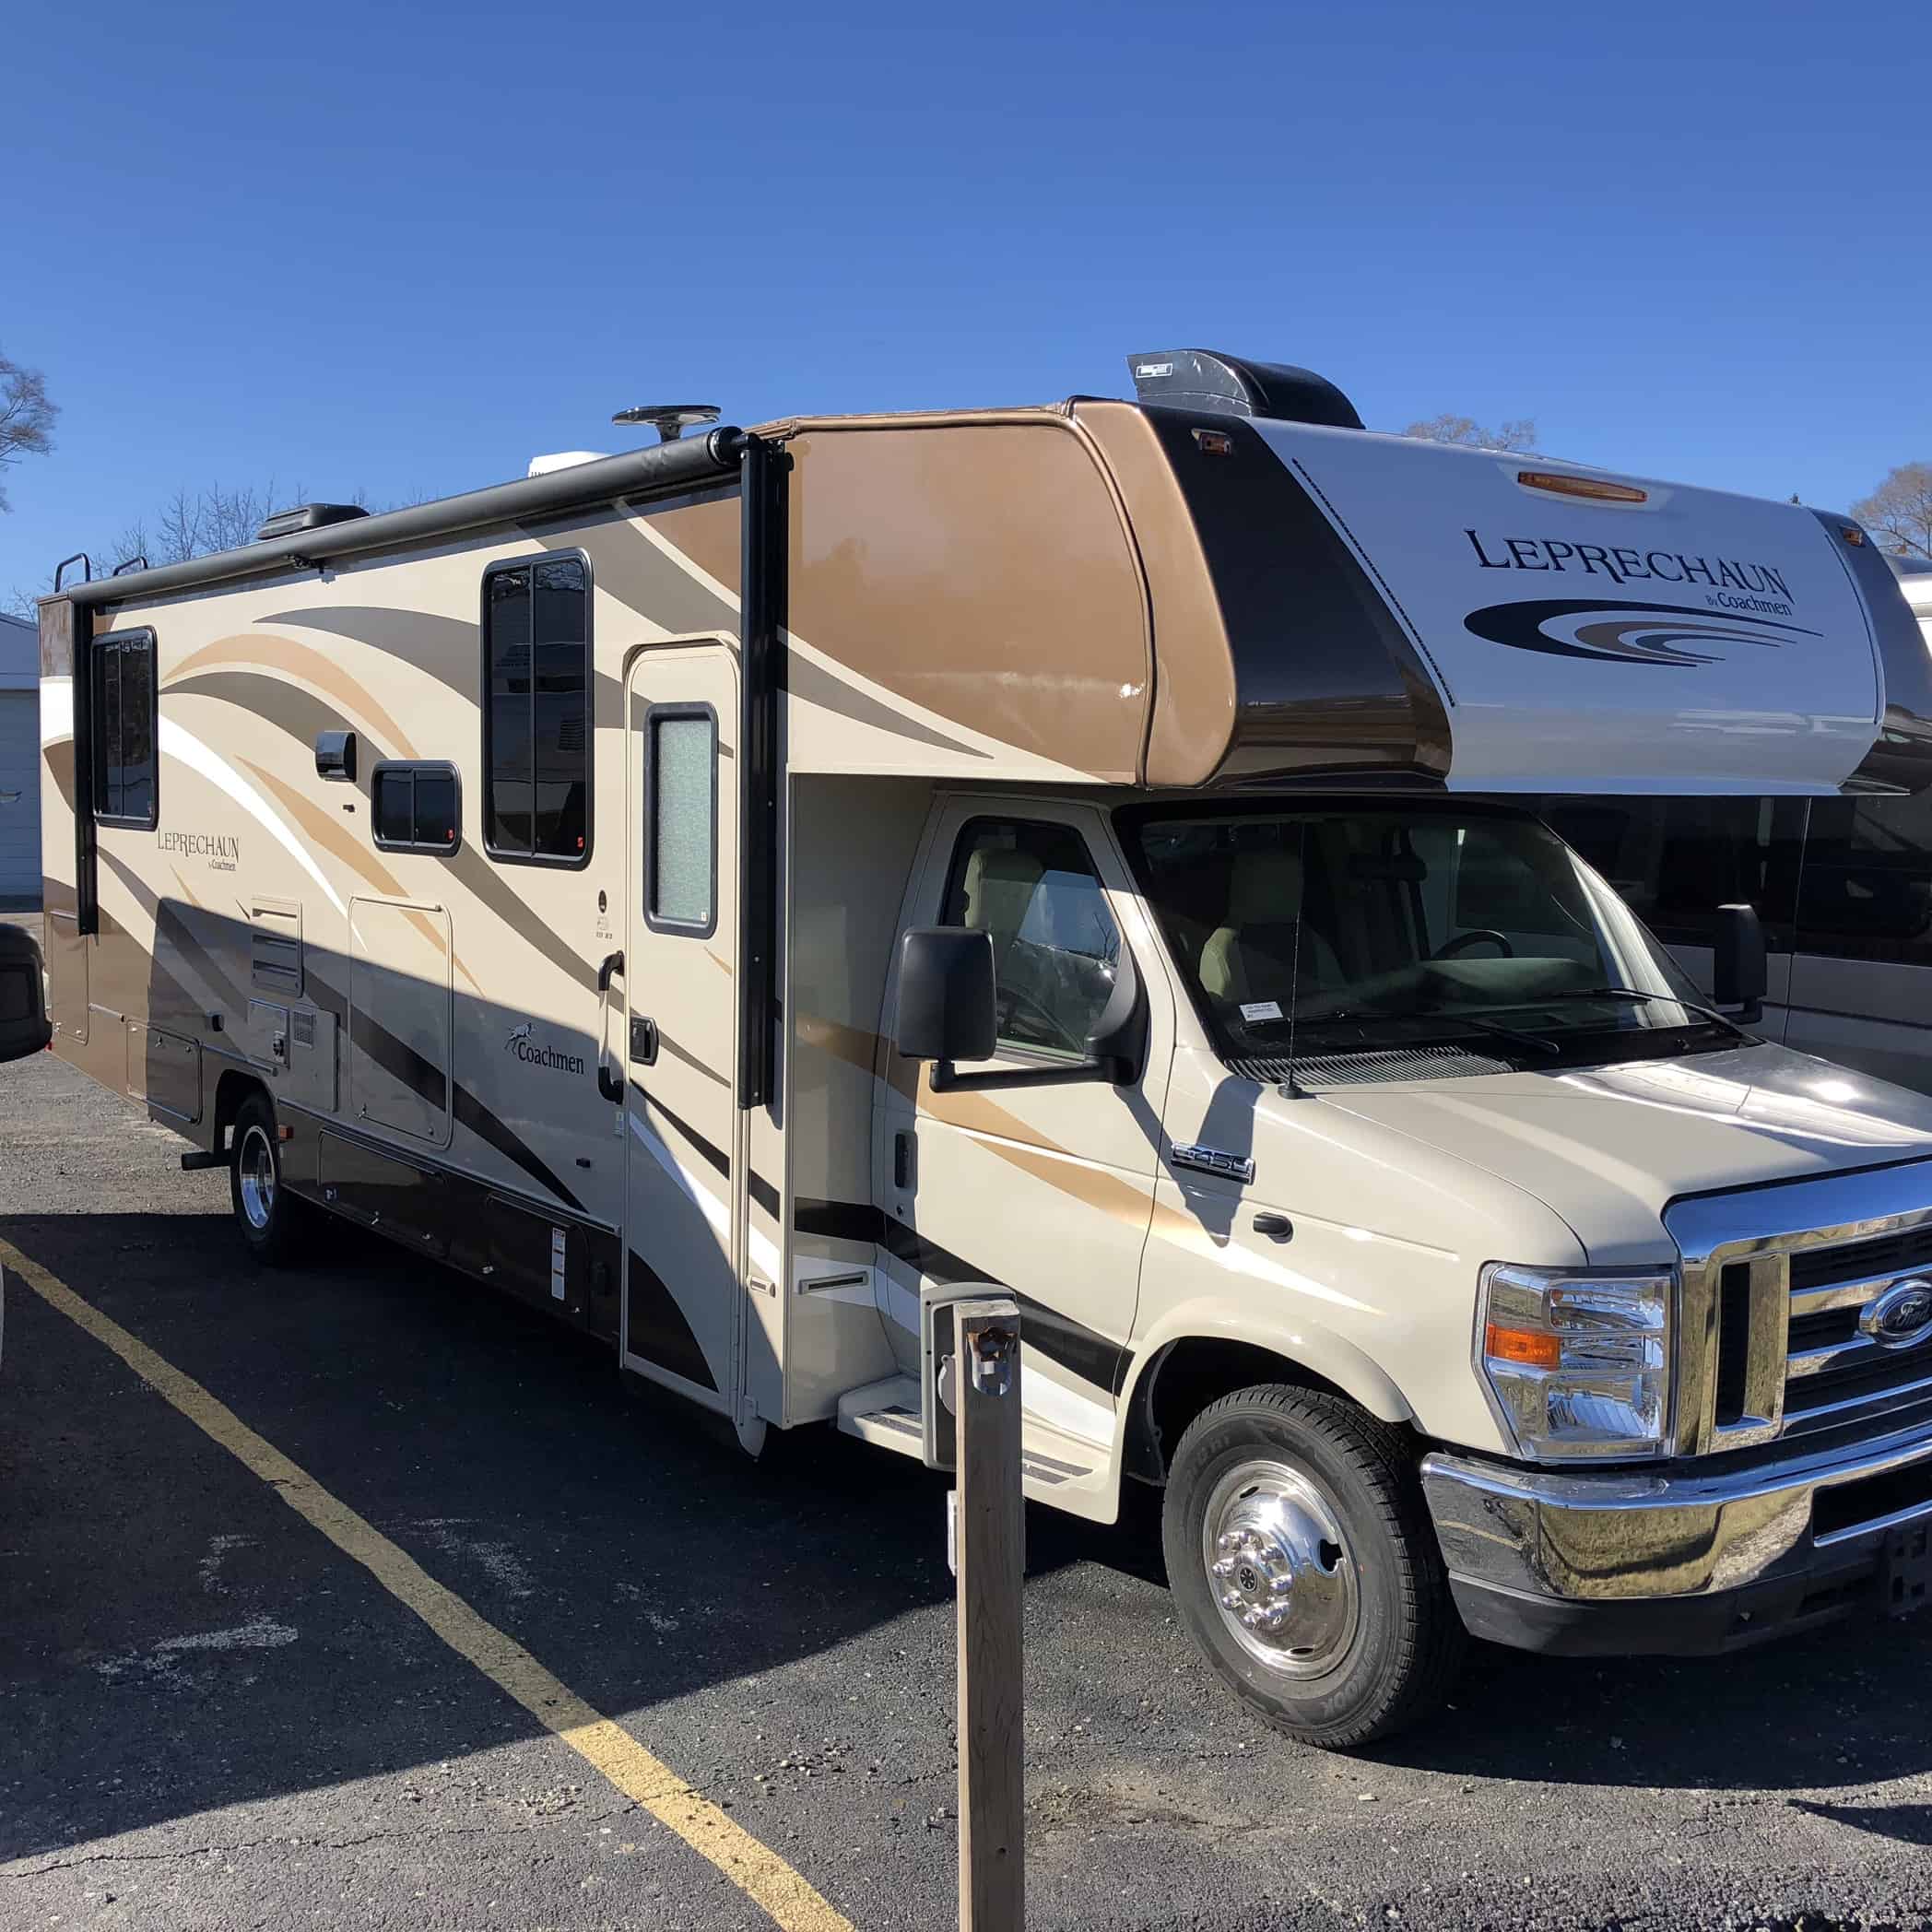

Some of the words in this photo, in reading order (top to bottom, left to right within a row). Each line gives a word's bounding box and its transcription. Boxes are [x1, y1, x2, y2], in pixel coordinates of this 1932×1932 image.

[1464, 528, 1796, 605] LEPRECHAUN
[1717, 592, 1793, 616] Coachmen
[157, 826, 240, 863] LEPRECHAUN
[517, 1041, 585, 1075] Coachmen
